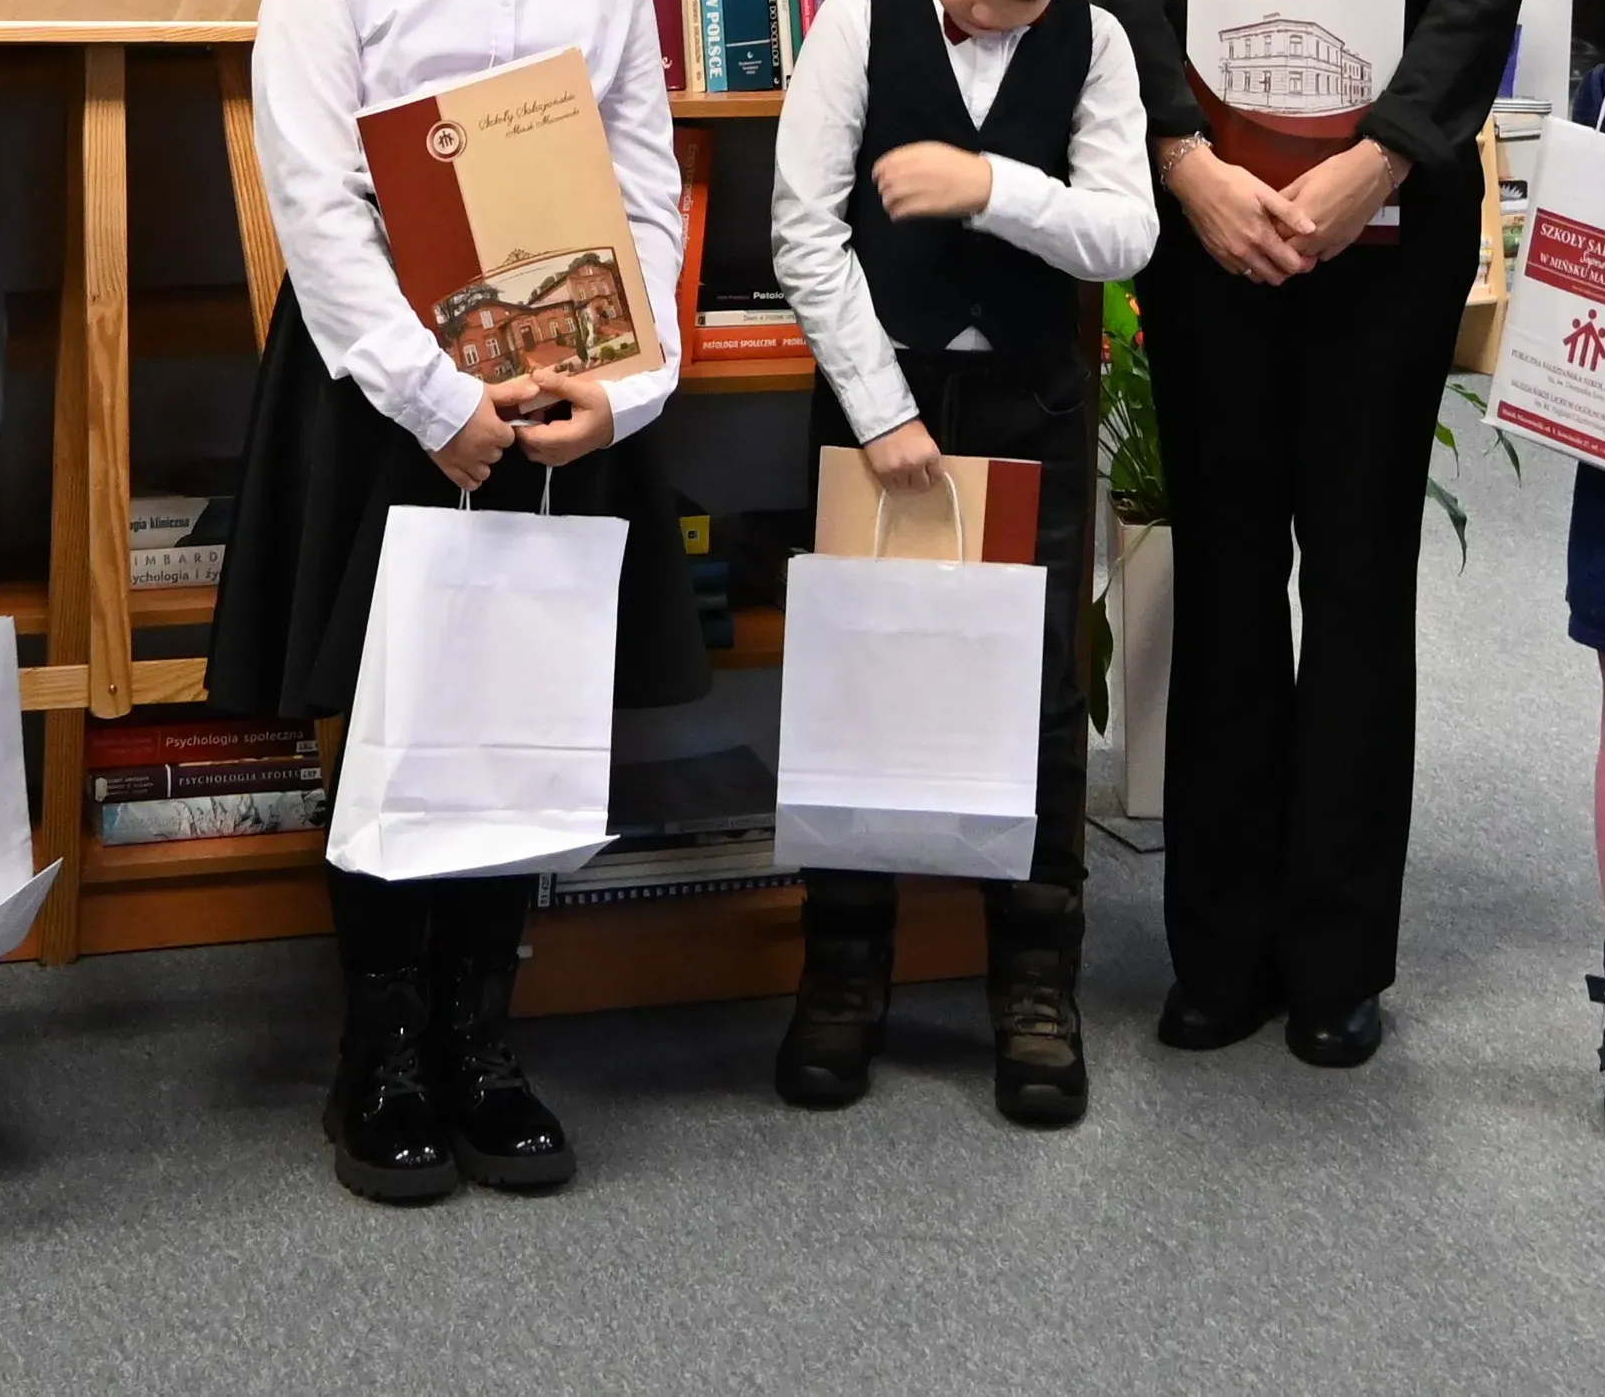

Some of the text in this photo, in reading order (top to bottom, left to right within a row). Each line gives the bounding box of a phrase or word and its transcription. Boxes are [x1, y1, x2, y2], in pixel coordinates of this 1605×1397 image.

[768, 6, 777, 20] DO
[706, 12, 724, 79] POLSCE
[770, 21, 780, 67] SOCJOLOGII
[1540, 224, 1586, 248] SZKOŁY
[1539, 253, 1549, 263] W
[1550, 256, 1589, 278] MIŃSKU
[703, 339, 739, 350] PATOLOGIE
[740, 338, 776, 348] SPOŁECZNE
[149, 516, 189, 529] kliniczna
[166, 729, 304, 748] Psychologia społeczna
[179, 772, 257, 786] PSYCHOLOGIA
